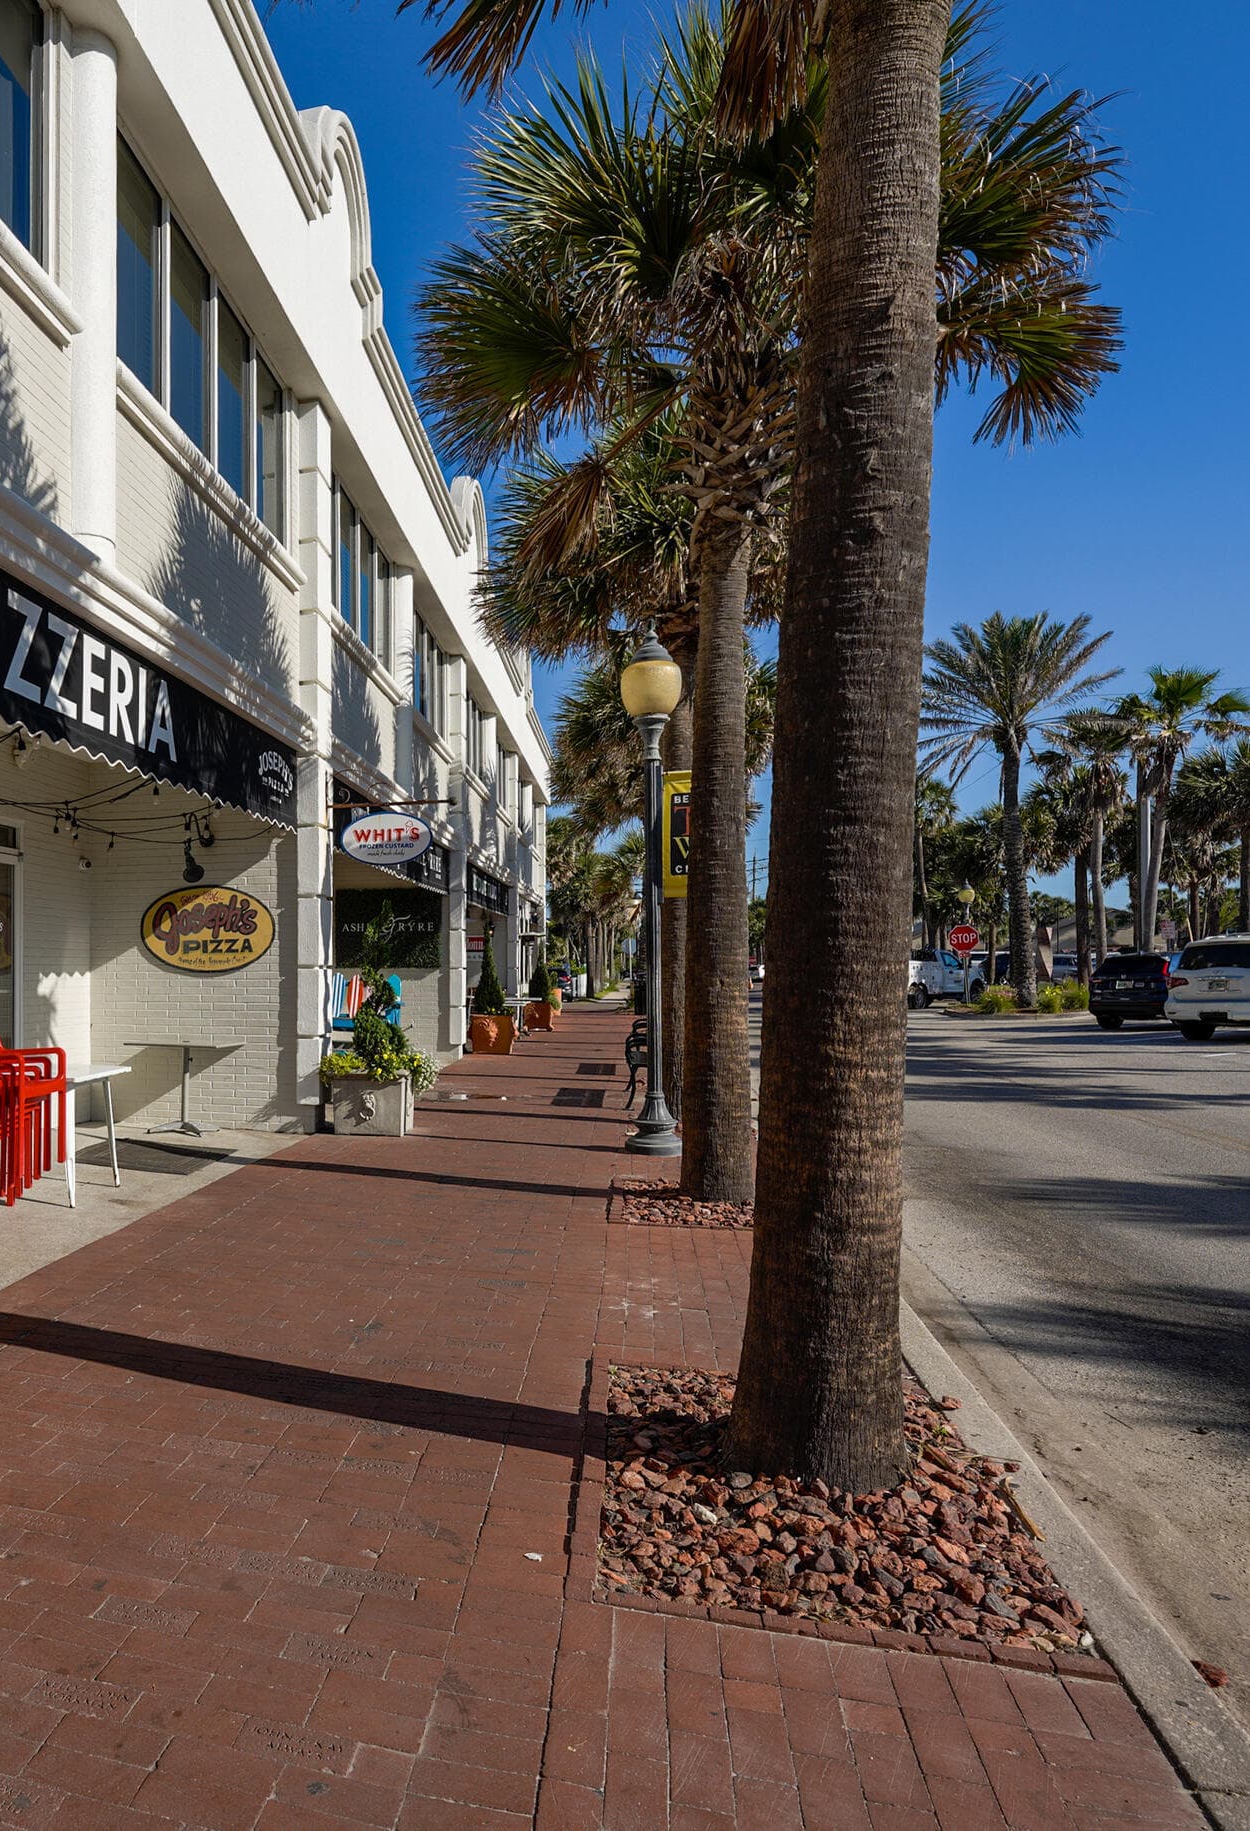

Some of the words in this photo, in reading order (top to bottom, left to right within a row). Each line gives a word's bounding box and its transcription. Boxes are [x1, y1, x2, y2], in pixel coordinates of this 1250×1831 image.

[258, 750, 294, 791] JOSEPH'S
[353, 826, 420, 843] WHIT'S
[152, 894, 258, 956] Joseph's
[183, 938, 254, 954] PIZZA
[950, 932, 977, 944] STOP
